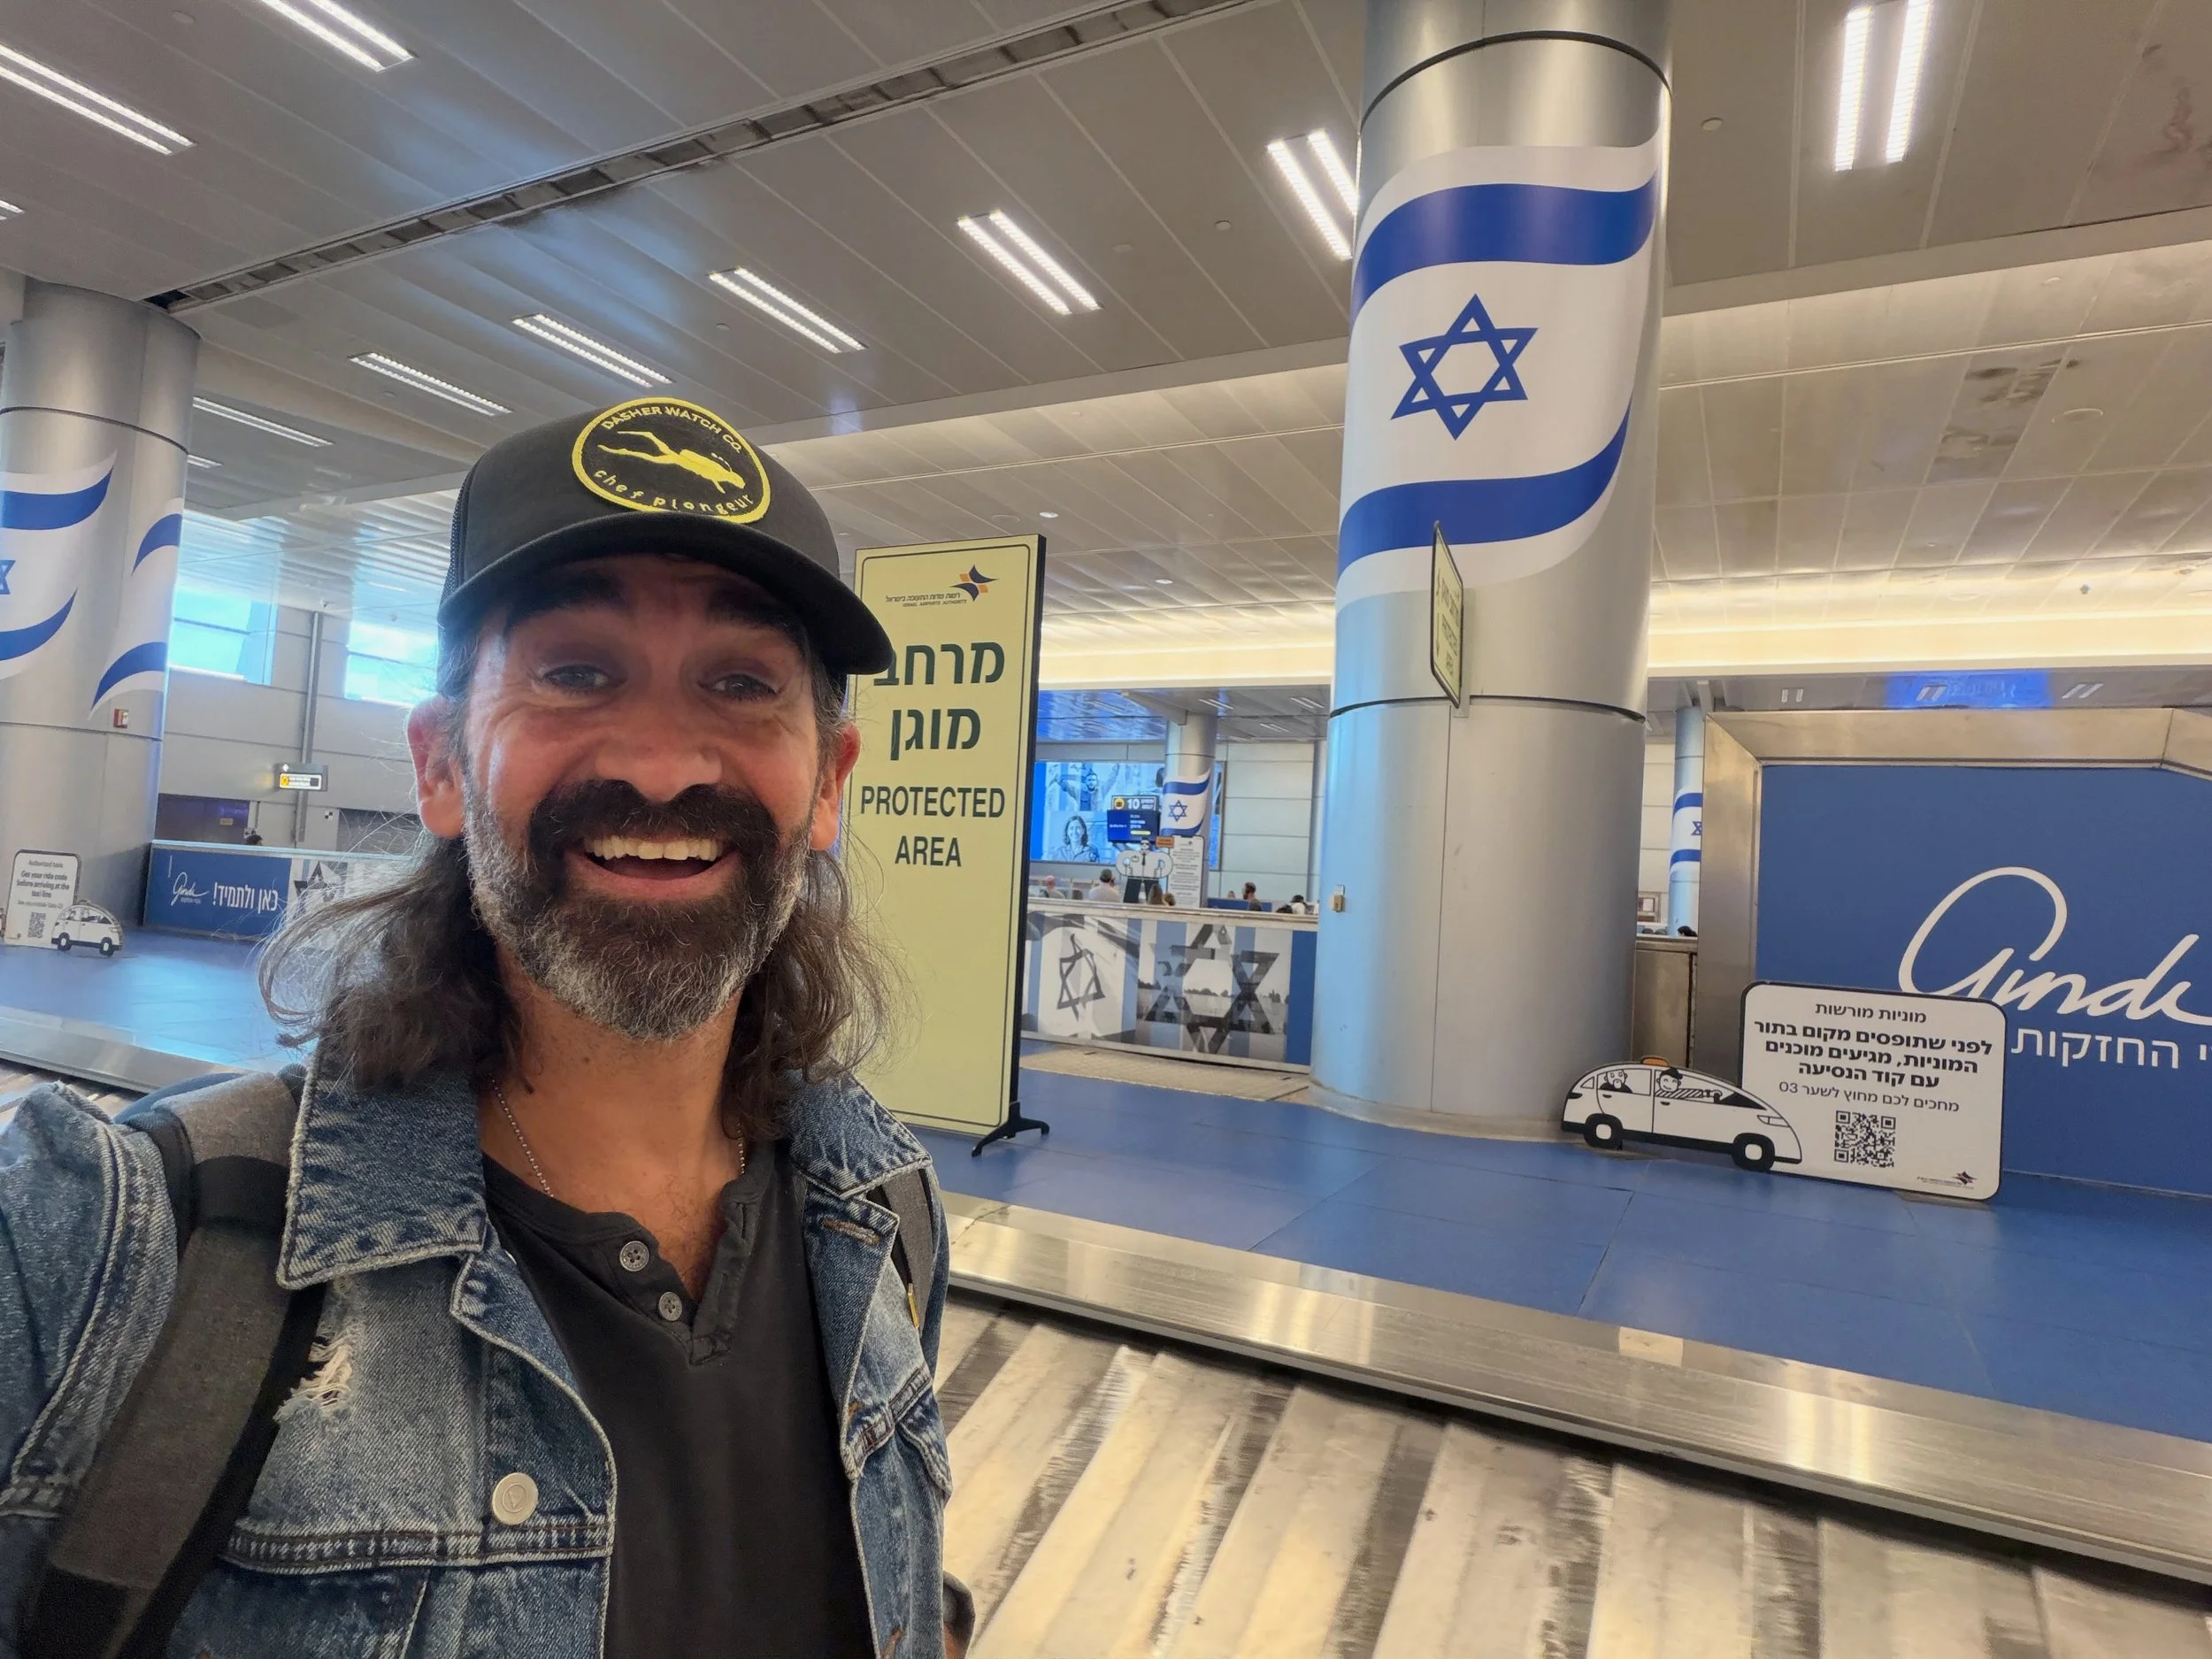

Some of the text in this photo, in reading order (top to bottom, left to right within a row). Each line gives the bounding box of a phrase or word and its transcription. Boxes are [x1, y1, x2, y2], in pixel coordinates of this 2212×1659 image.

[601, 406, 662, 430] DASHER
[664, 406, 721, 434] WATCH
[594, 470, 754, 515] chef plongeur
[890, 708, 981, 761] מוגן
[860, 786, 1005, 818] PROTECTED
[1127, 798, 1141, 810] 10
[895, 835, 962, 867] AREA
[212, 881, 278, 914] כאן ולתמיד!
[1815, 1002, 1926, 1023] מוניות מורשות
[1754, 1020, 1993, 1055] לפני שתופסים מקום בתור
[2011, 1028, 2179, 1069] החזקות
[1765, 1040, 1978, 1073] המוניות, מגיעים מוכנים
[1799, 1062, 1939, 1087] עם קוד הנסיעה
[1778, 1081, 1960, 1112] מחכים לכם מחוץ לשער 03
